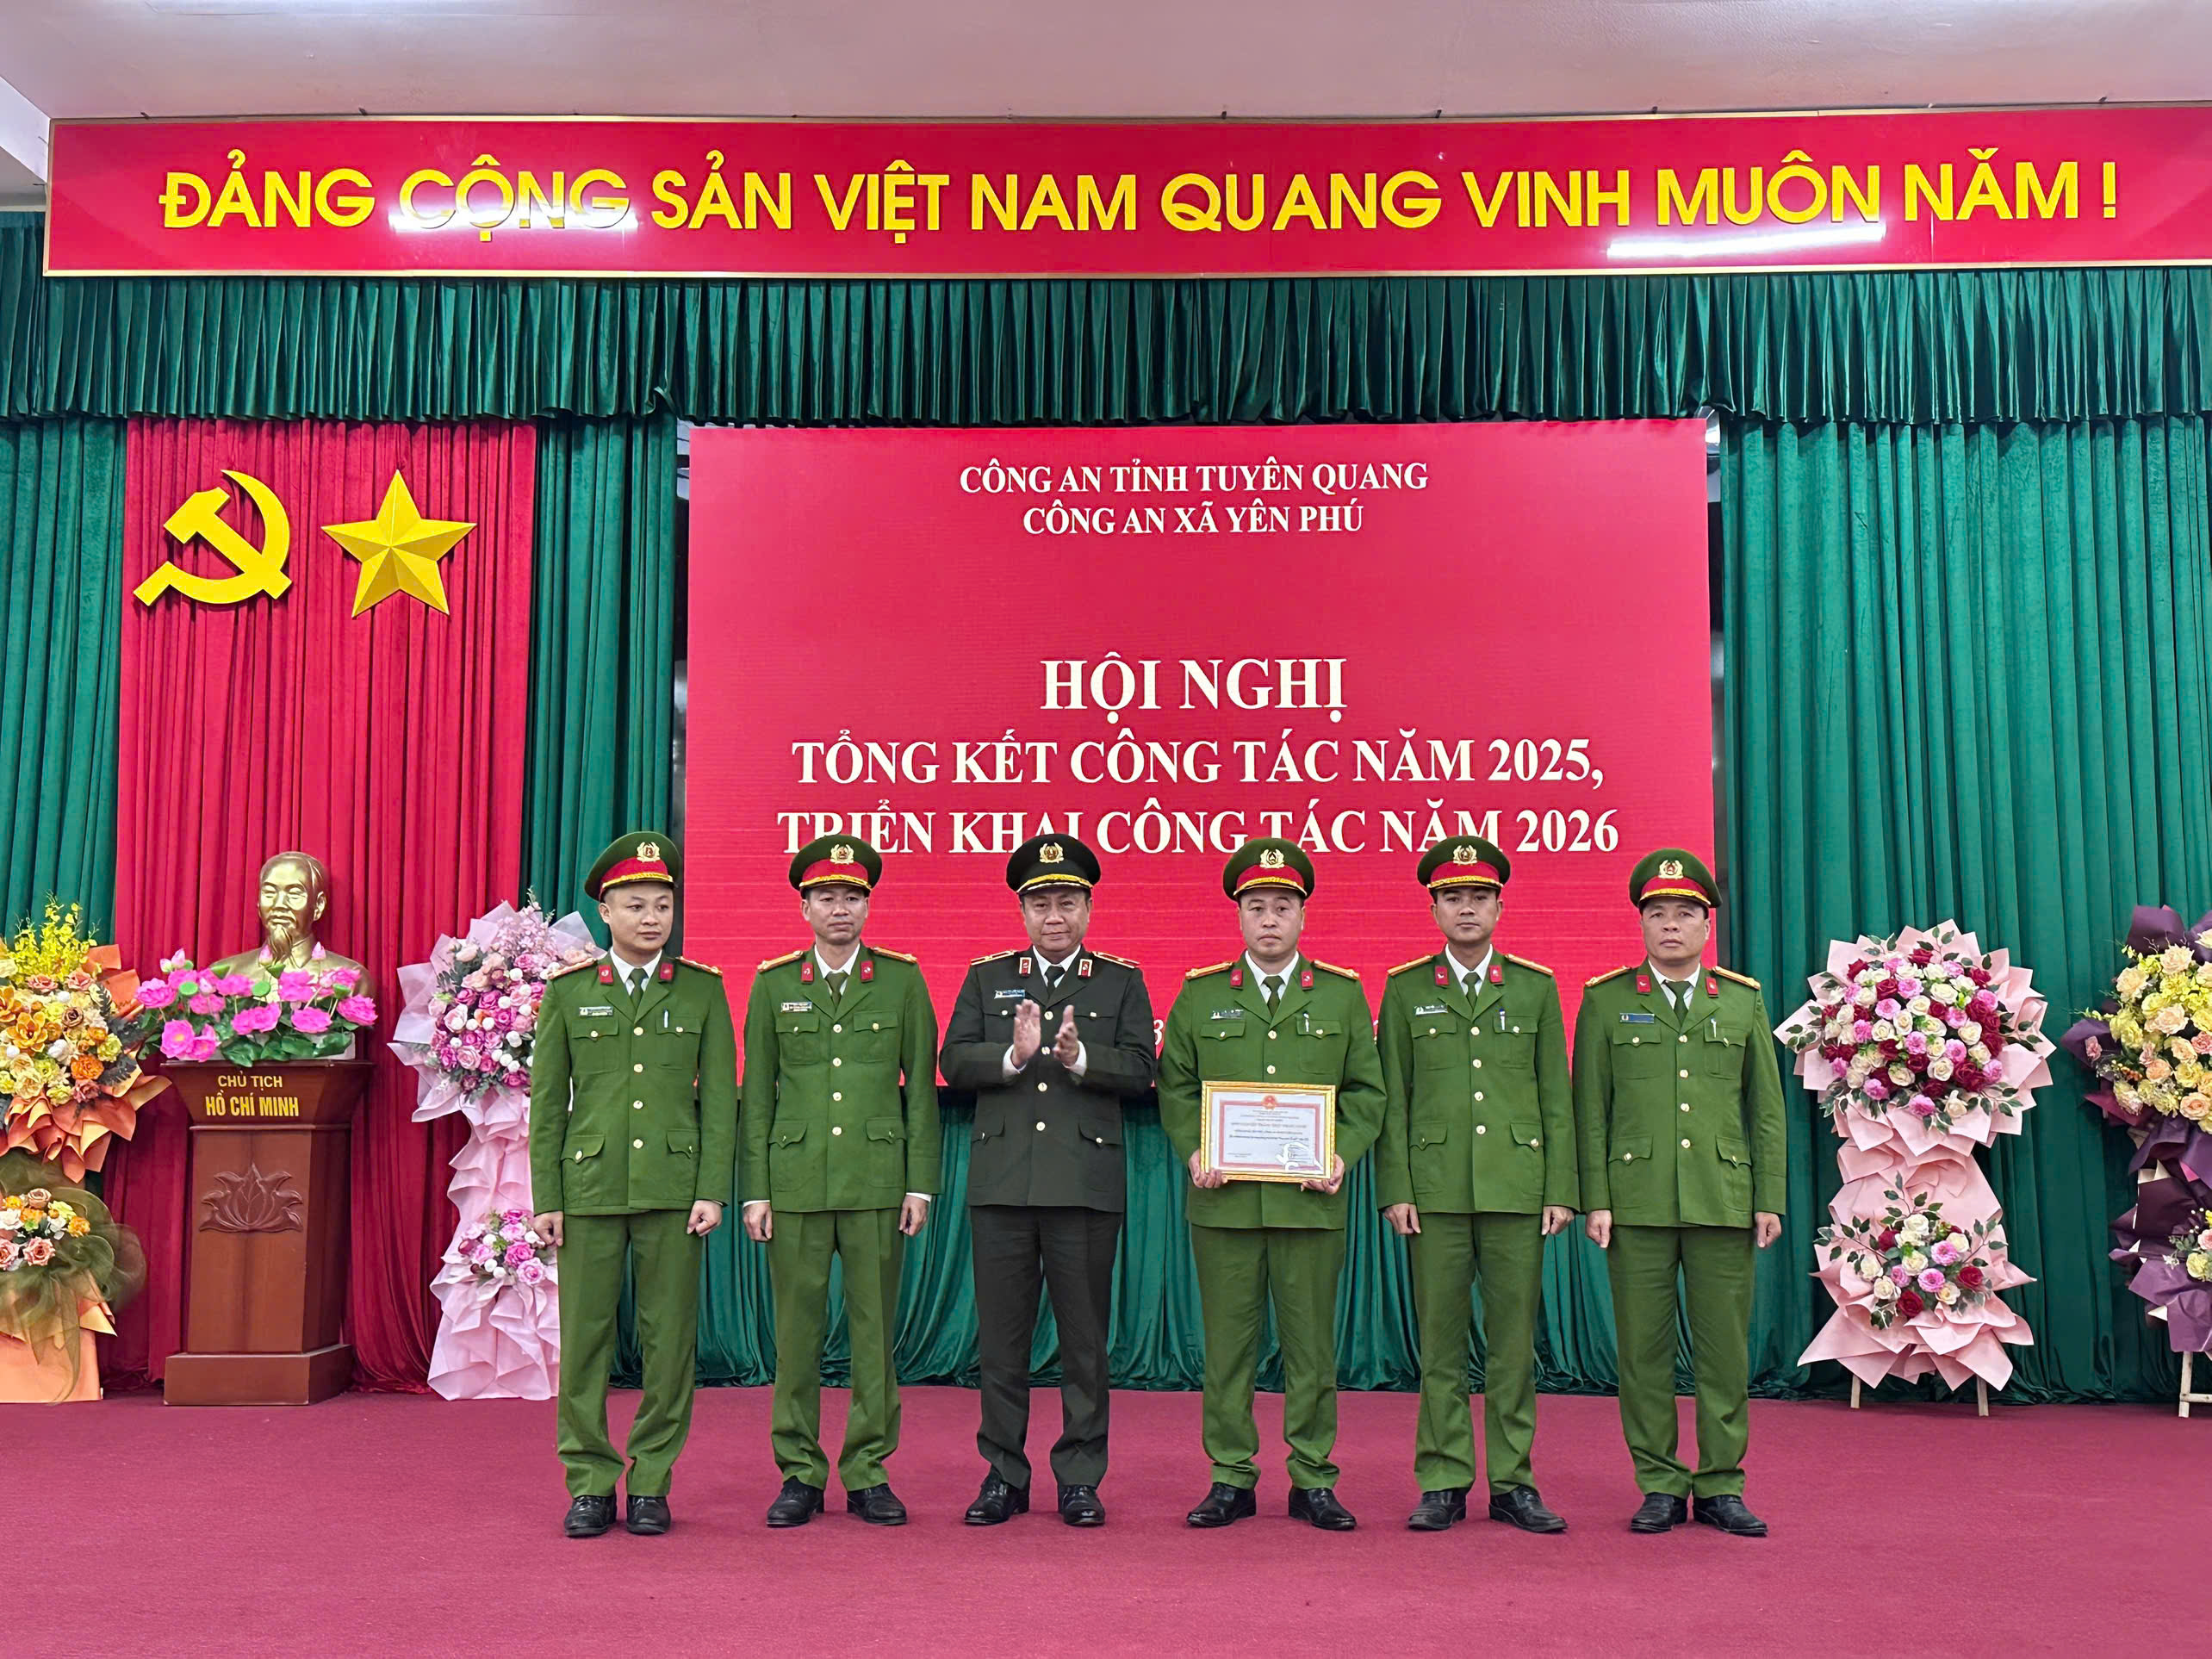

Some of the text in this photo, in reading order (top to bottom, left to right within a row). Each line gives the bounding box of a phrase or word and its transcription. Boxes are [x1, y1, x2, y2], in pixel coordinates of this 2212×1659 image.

[158, 147, 2116, 244] ĐẢNG CỘNG SẢN VIỆT NAM QUANG VINH MUÔN NĂM !
[960, 456, 1428, 495] CÔNG AN TỈNH TUYÊN QUANG
[1022, 497, 1364, 535] CÔNG AN XÃ YÊN PHÚ
[1040, 651, 1348, 724] HỘI NGHỊ
[791, 727, 1603, 789] TỔNG KẾT CÔNG TÁC NĂM 2025,
[1097, 797, 1249, 854] CÔNG
[1259, 798, 1365, 853] TÁC
[1379, 798, 1503, 853] NĂM
[1516, 809, 1619, 853] 2026
[205, 1089, 299, 1117] HỒ CHÍ MINH
[217, 1070, 283, 1091] CHỦ TỊCH
